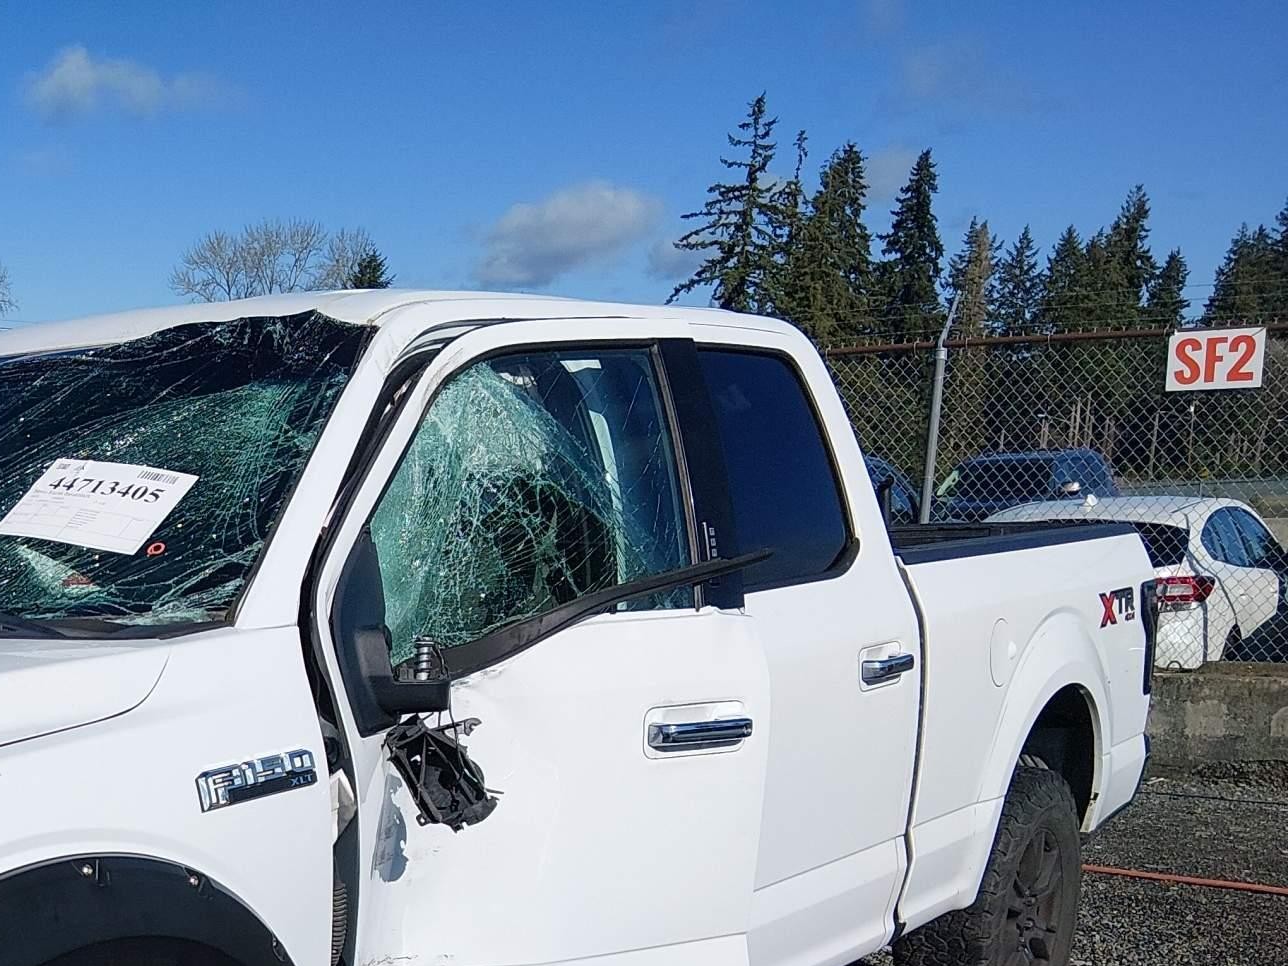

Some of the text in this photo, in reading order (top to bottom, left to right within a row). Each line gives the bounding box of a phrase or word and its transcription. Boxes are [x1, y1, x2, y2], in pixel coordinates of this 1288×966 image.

[1173, 333, 1257, 386] SF2
[48, 475, 166, 504] 44713405
[1098, 586, 1136, 629] XTR
[290, 773, 314, 787] XLT
